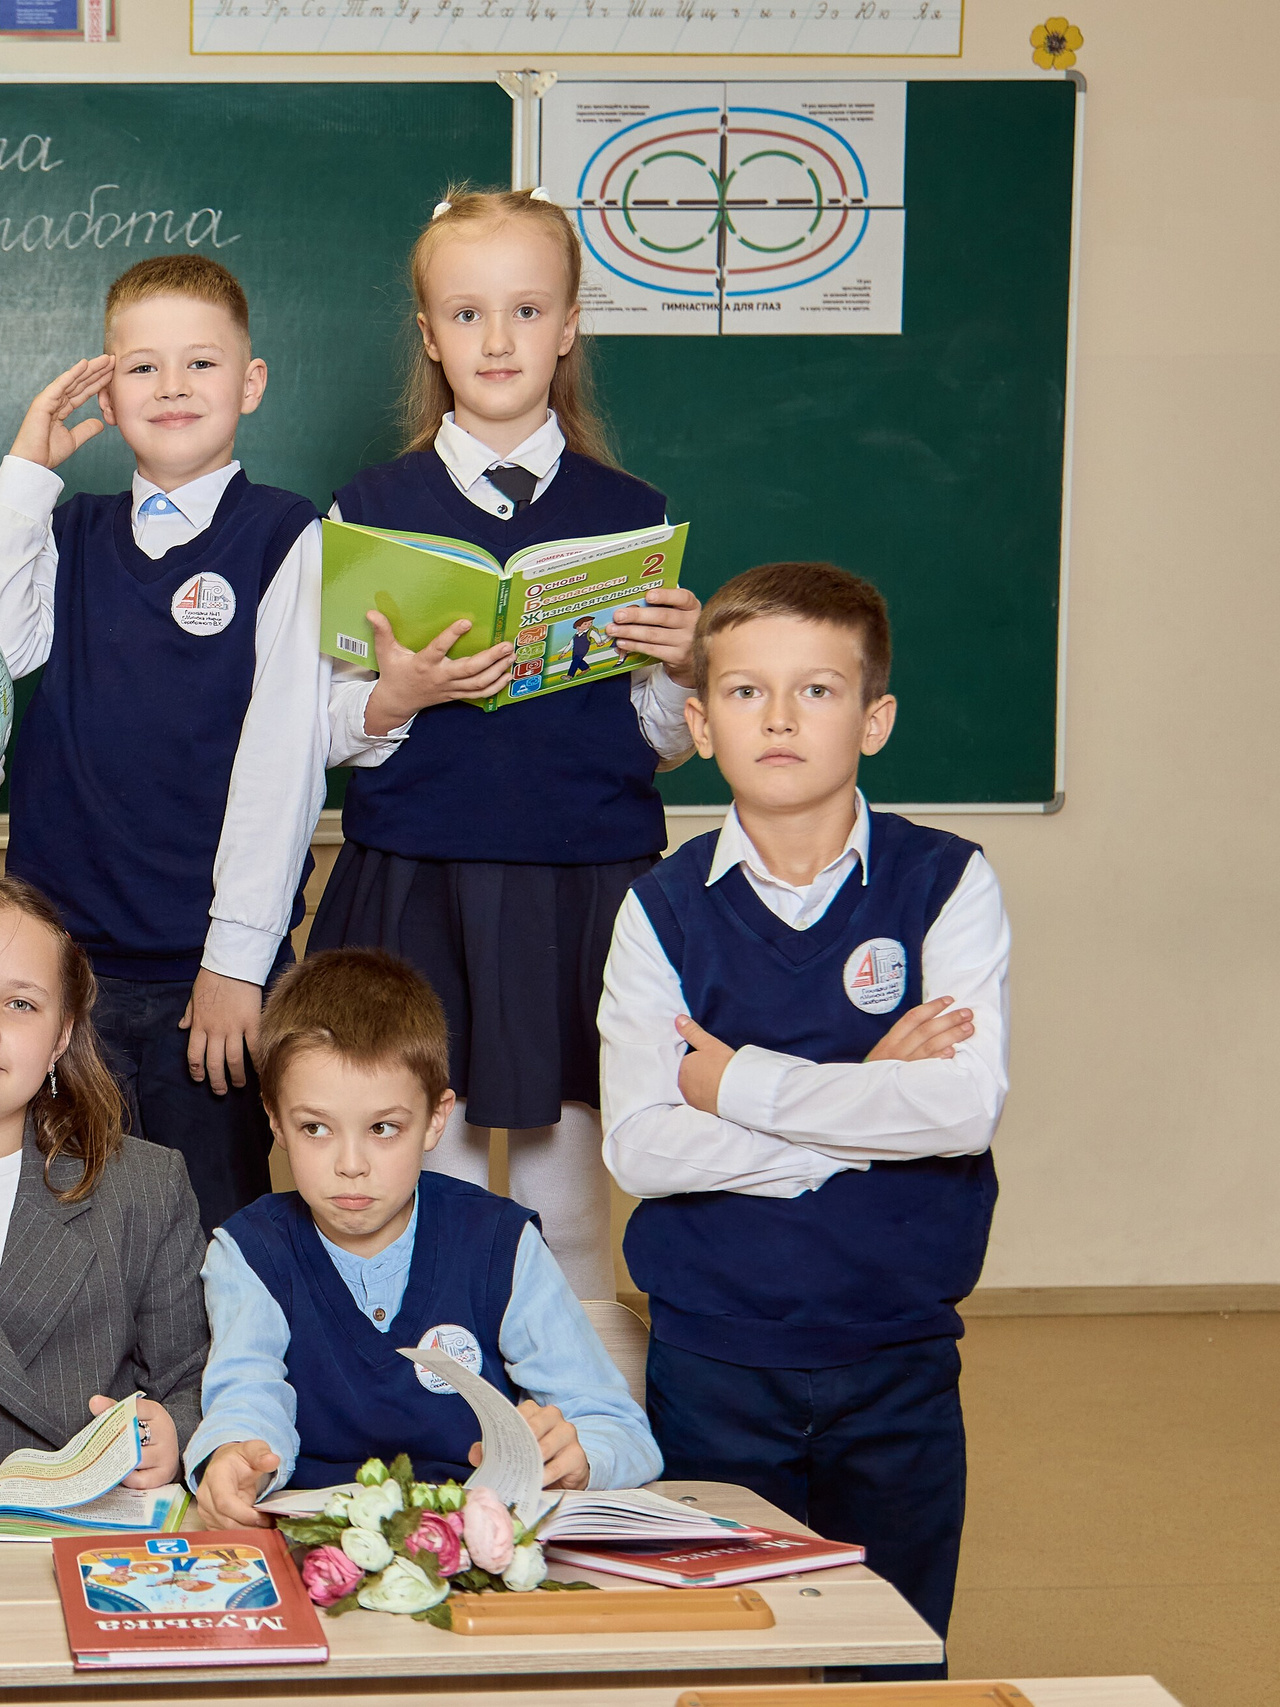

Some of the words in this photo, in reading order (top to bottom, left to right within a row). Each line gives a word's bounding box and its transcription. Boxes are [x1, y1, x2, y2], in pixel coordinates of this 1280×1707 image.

[733, 302, 754, 313] ДЛЯ
[756, 302, 782, 312] ГЛАЗ
[640, 552, 666, 578] 2
[524, 576, 627, 613] Безопасности
[526, 573, 588, 598] Основы
[520, 580, 663, 627] Жизнедеятельности
[157, 1542, 180, 1553] 2
[94, 1614, 288, 1633] Музыка
